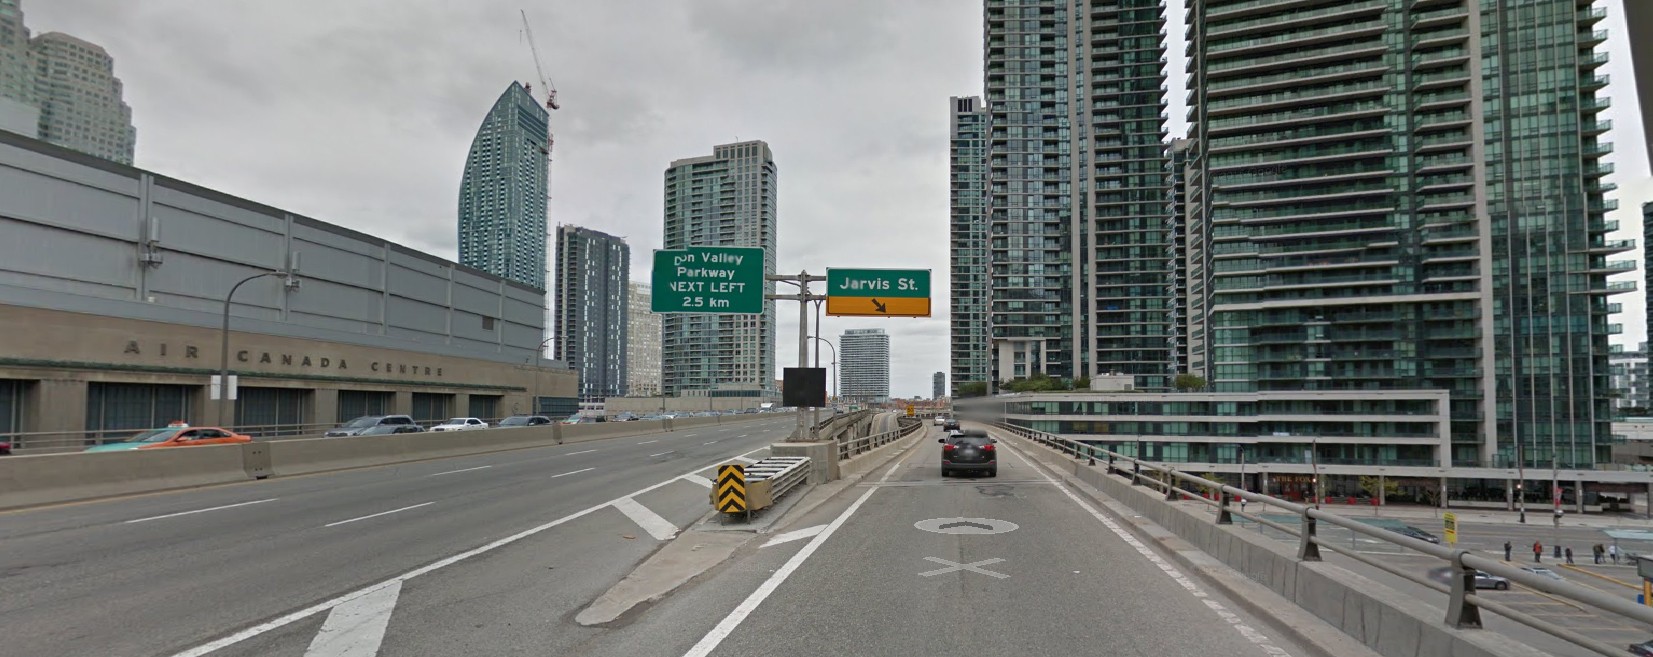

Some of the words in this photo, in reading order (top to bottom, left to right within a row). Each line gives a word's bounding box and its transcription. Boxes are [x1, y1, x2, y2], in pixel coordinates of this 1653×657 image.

[701, 252, 744, 266] Valley
[677, 266, 735, 280] Parkway
[669, 281, 705, 292] NEXT
[710, 282, 746, 293] LEFT
[839, 277, 890, 290] Jarvis
[897, 277, 918, 291] St.
[682, 296, 704, 307] 2.5
[709, 297, 730, 308] km
[123, 340, 199, 359] AIR
[237, 350, 347, 369] CANADA
[371, 361, 442, 376] CENTRE
